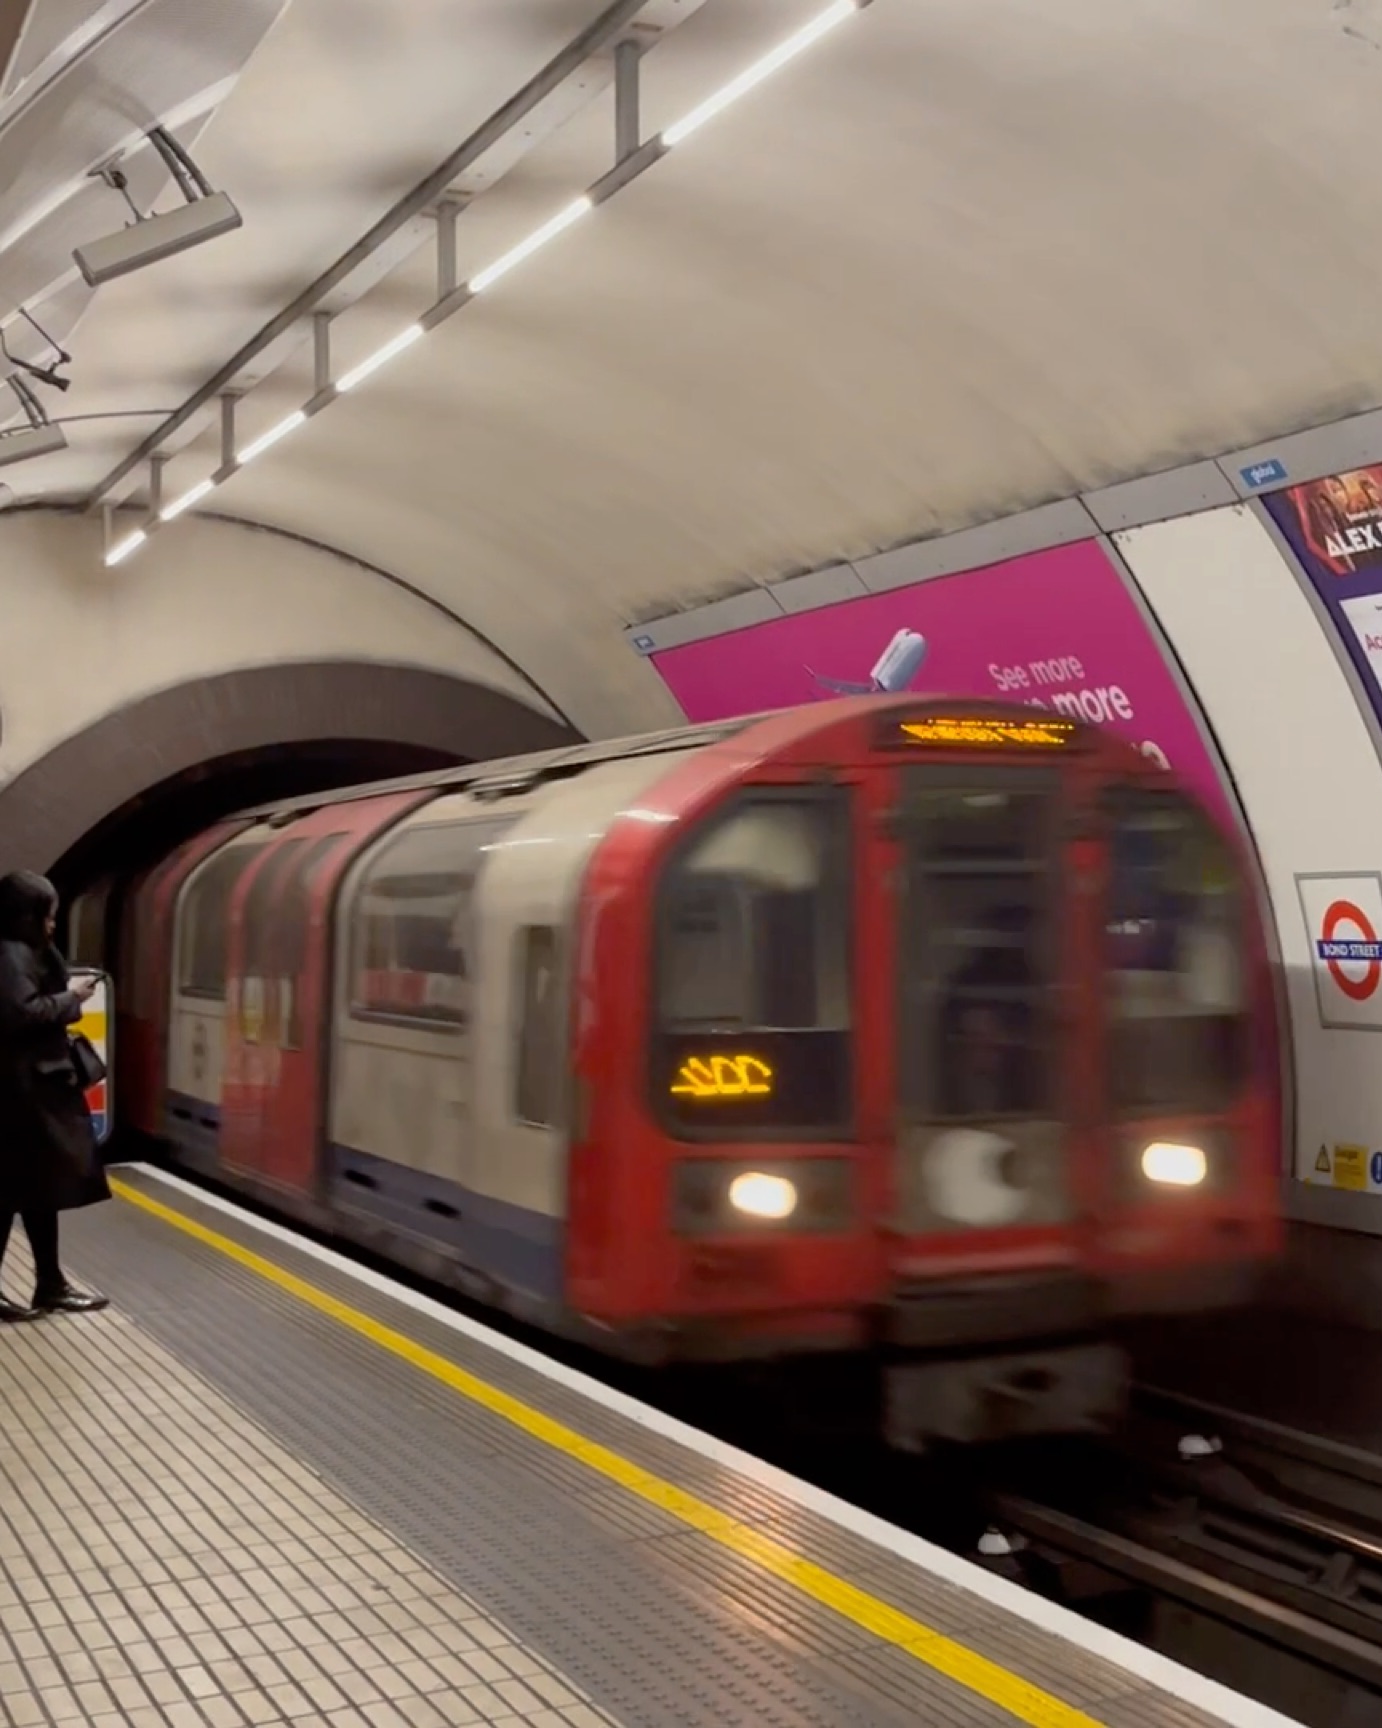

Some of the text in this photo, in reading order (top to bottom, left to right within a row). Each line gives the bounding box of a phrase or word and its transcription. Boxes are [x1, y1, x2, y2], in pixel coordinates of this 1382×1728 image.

[1325, 525, 1382, 557] ALEX
[988, 655, 1085, 691] See more
[1053, 684, 1134, 723] more
[1322, 943, 1380, 958] BOND STREET
